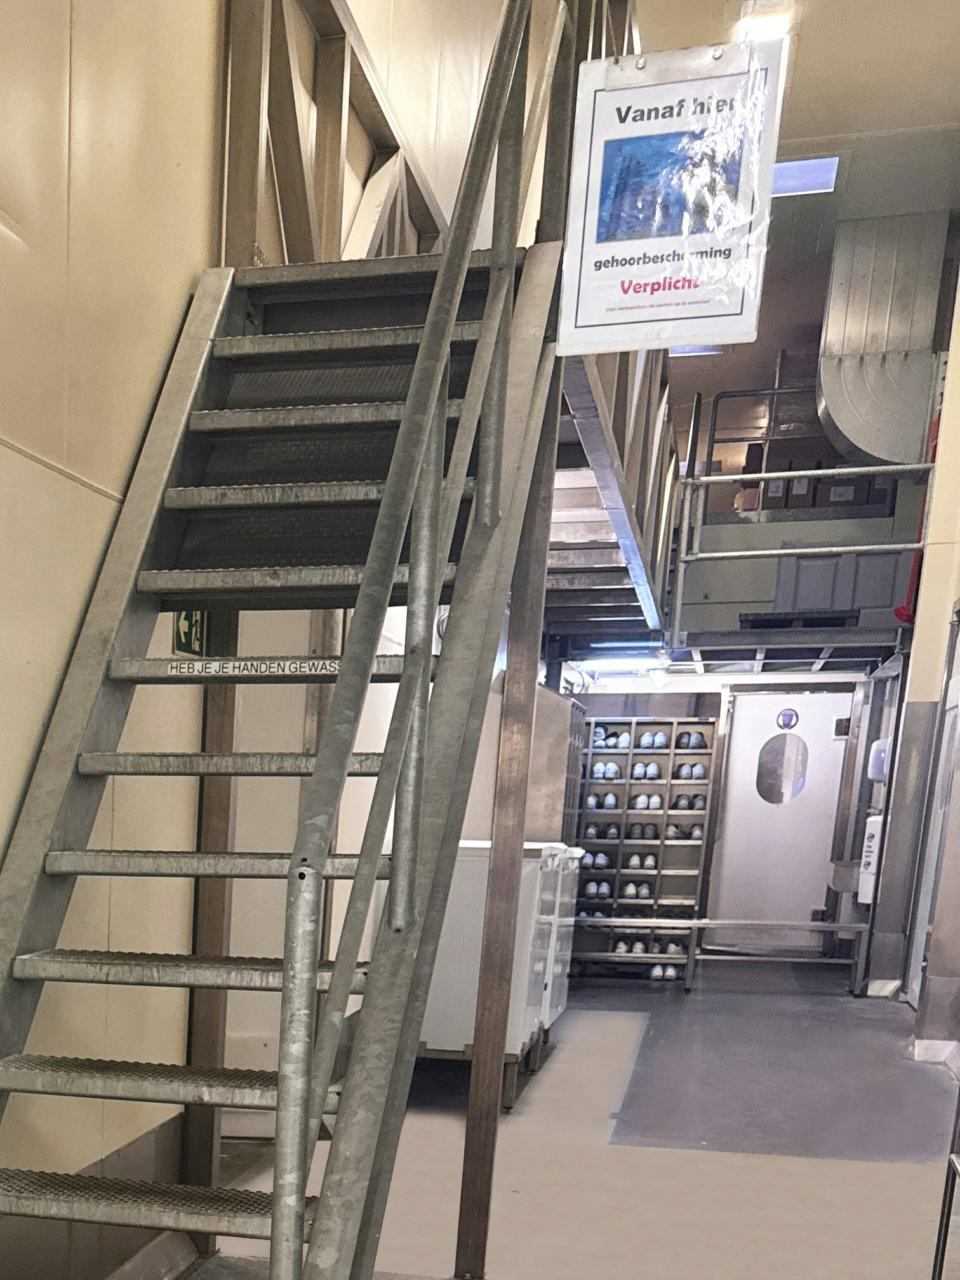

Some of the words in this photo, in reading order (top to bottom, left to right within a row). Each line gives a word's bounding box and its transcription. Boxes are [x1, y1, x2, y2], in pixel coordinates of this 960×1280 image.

[615, 98, 685, 124] Vanaf
[692, 95, 735, 116] hier
[169, 662, 195, 674] HEB
[197, 662, 212, 674] JE
[214, 661, 229, 674] JE
[232, 661, 286, 674] HANDEN
